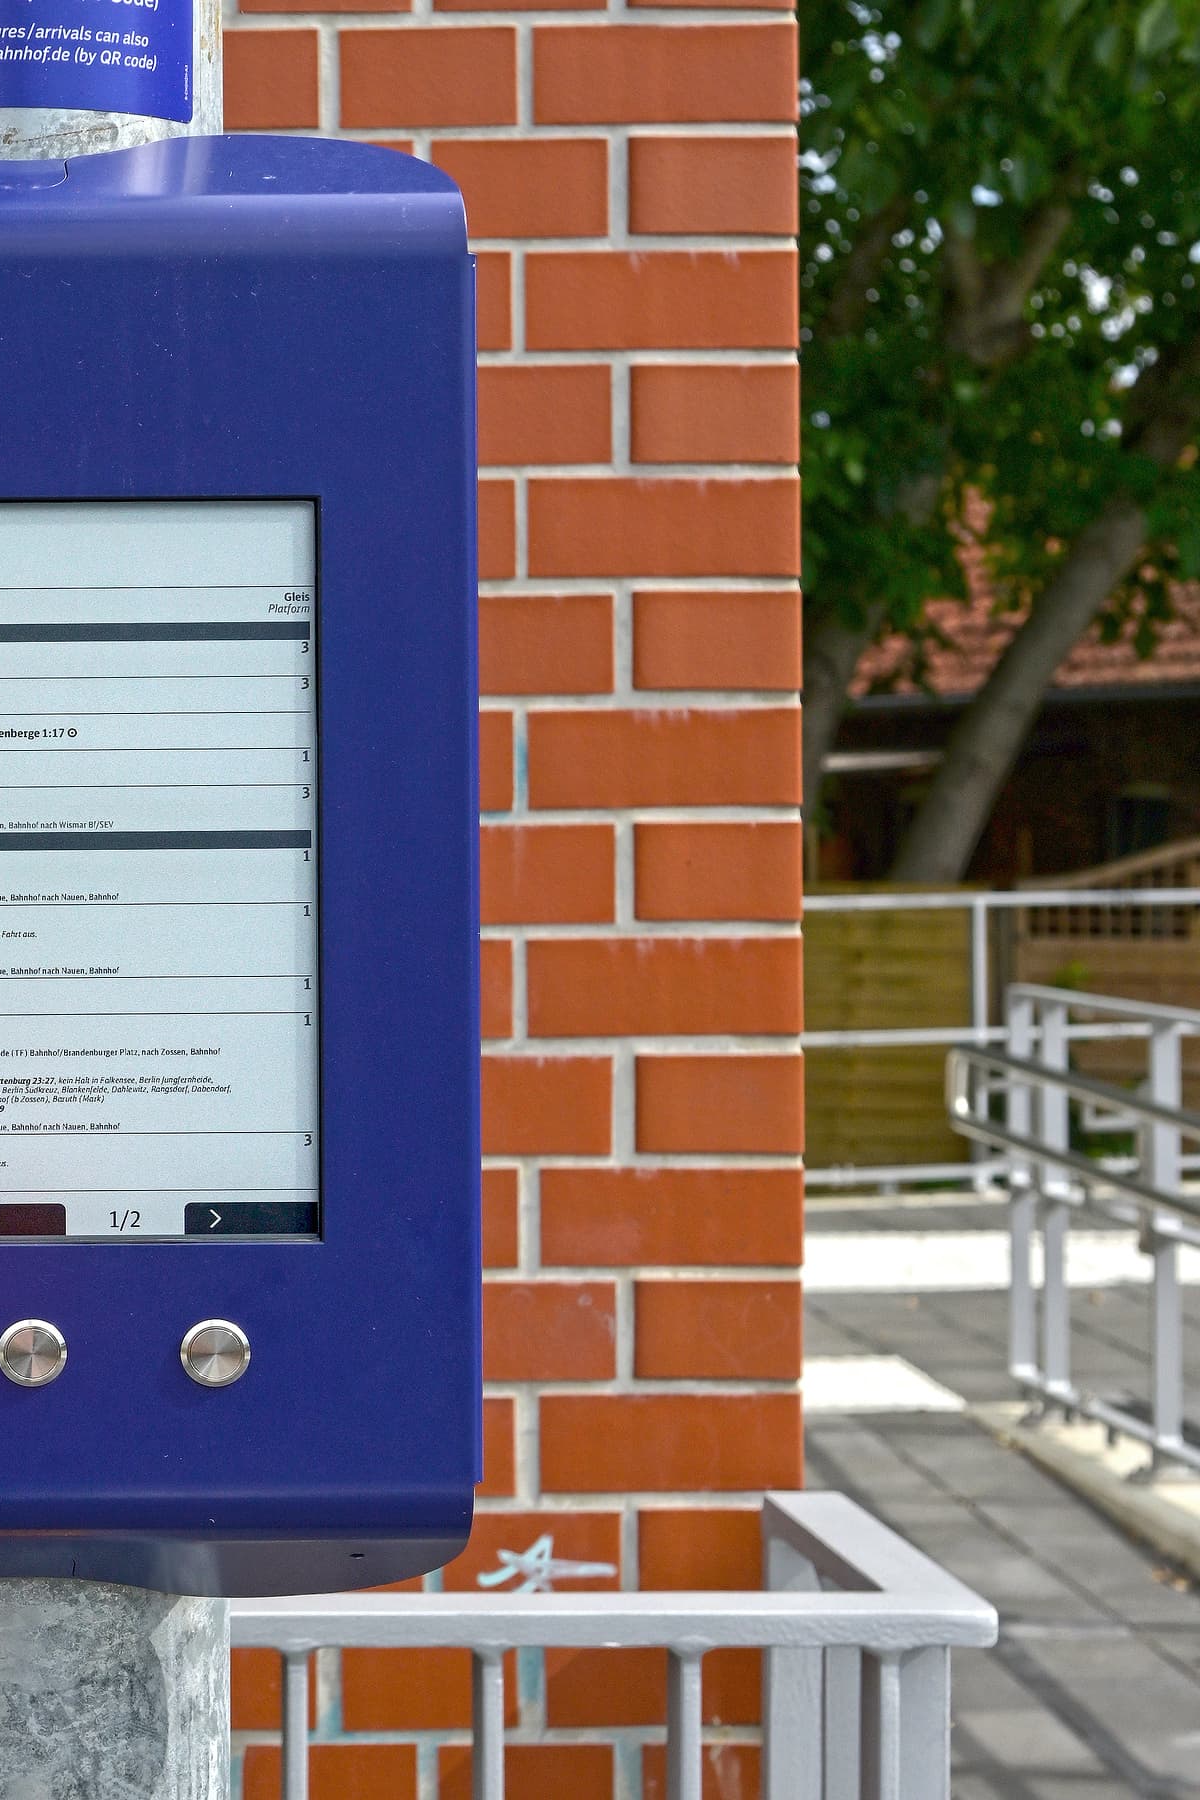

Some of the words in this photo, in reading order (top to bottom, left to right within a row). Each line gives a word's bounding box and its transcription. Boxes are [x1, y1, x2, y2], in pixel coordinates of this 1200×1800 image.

[95, 31, 119, 43] can
[122, 32, 149, 47] also
[74, 46, 96, 65] (by
[100, 50, 120, 66] QR
[124, 54, 157, 72] code)
[284, 592, 310, 602] Gleis
[268, 604, 310, 613] Platform
[301, 642, 309, 653] 3
[301, 678, 309, 689] 3
[42, 729, 64, 738] 1:17
[303, 750, 310, 761] 1
[302, 787, 310, 799] 3
[303, 851, 310, 861] 1
[303, 905, 311, 916] 1
[304, 979, 312, 989] 1
[304, 1015, 311, 1026] 1
[304, 1134, 312, 1146] 3
[109, 1210, 141, 1231] 1/2
